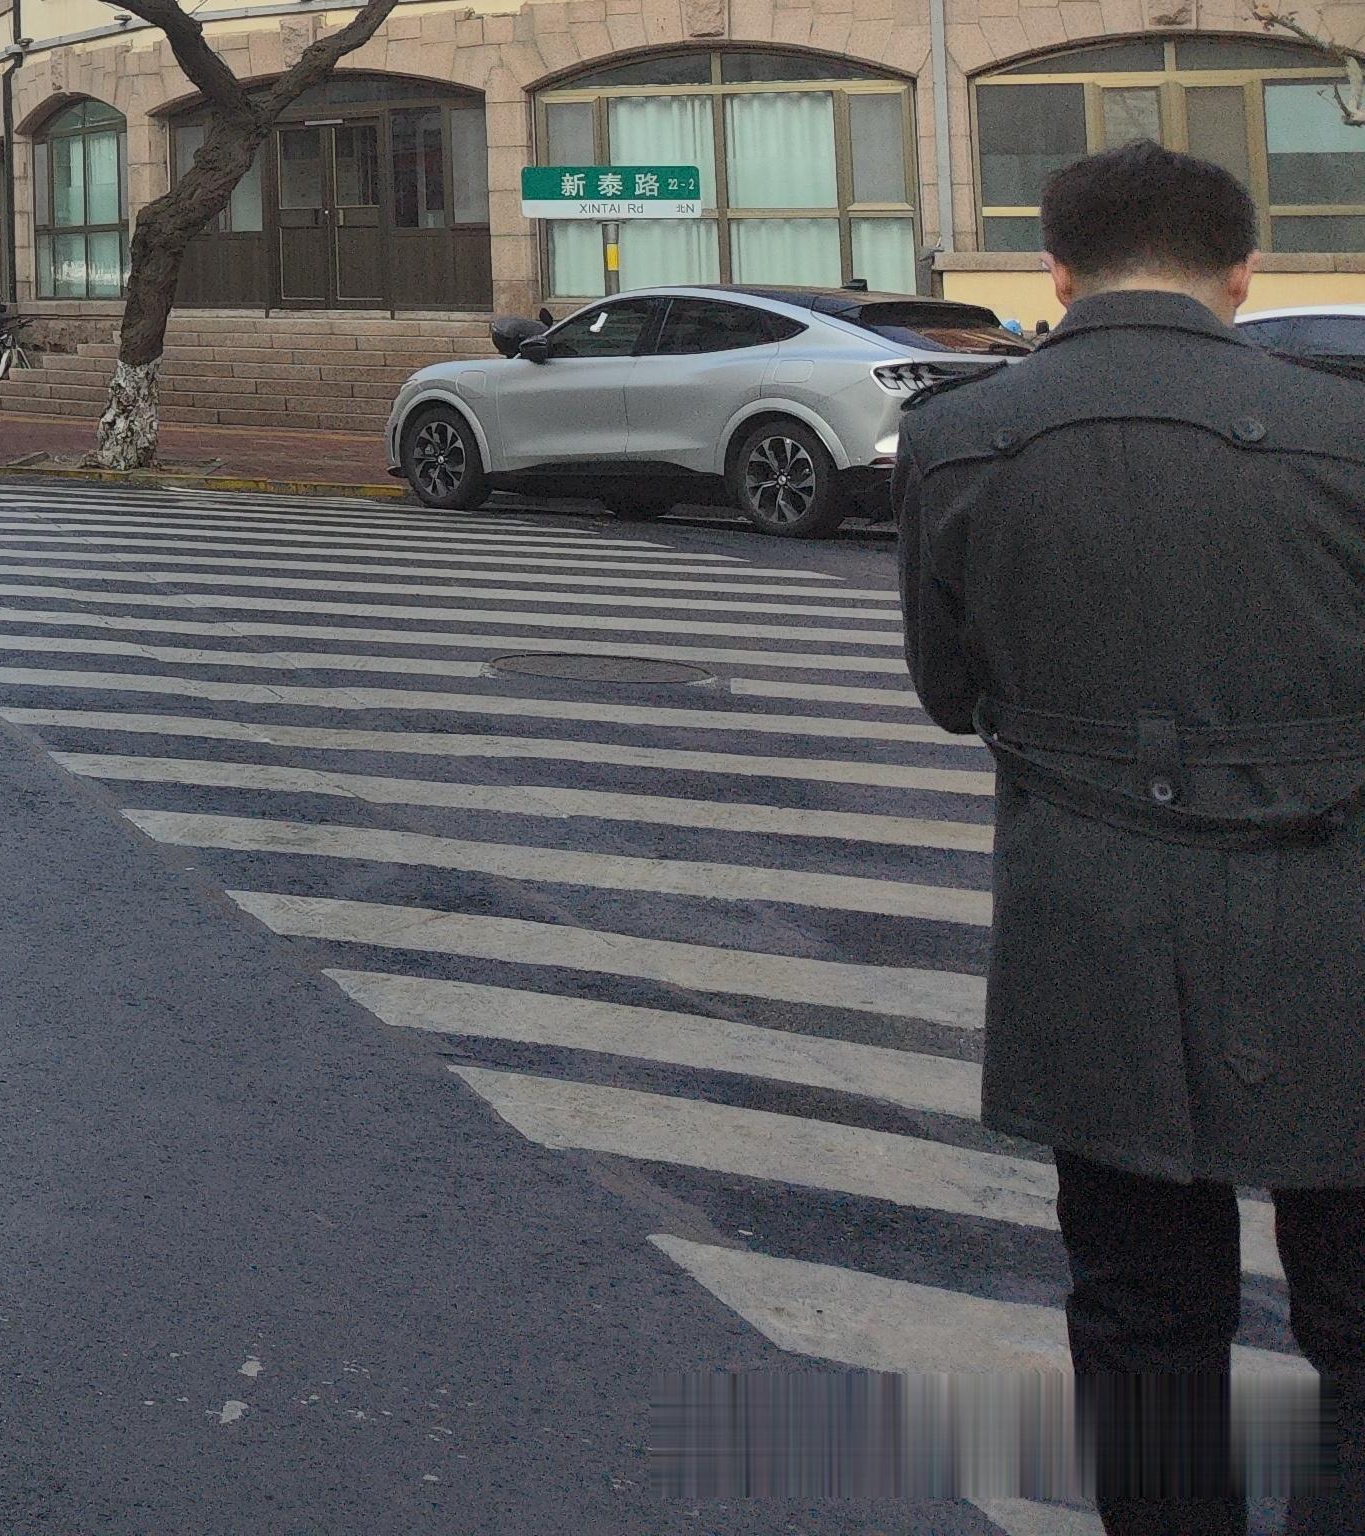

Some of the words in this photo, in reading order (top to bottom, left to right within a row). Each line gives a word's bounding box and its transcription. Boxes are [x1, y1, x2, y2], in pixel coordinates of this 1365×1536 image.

[561, 172, 659, 197] 新泰路
[667, 178, 695, 190] 22-2
[579, 203, 621, 214] XINTAI
[627, 203, 644, 214] Rd
